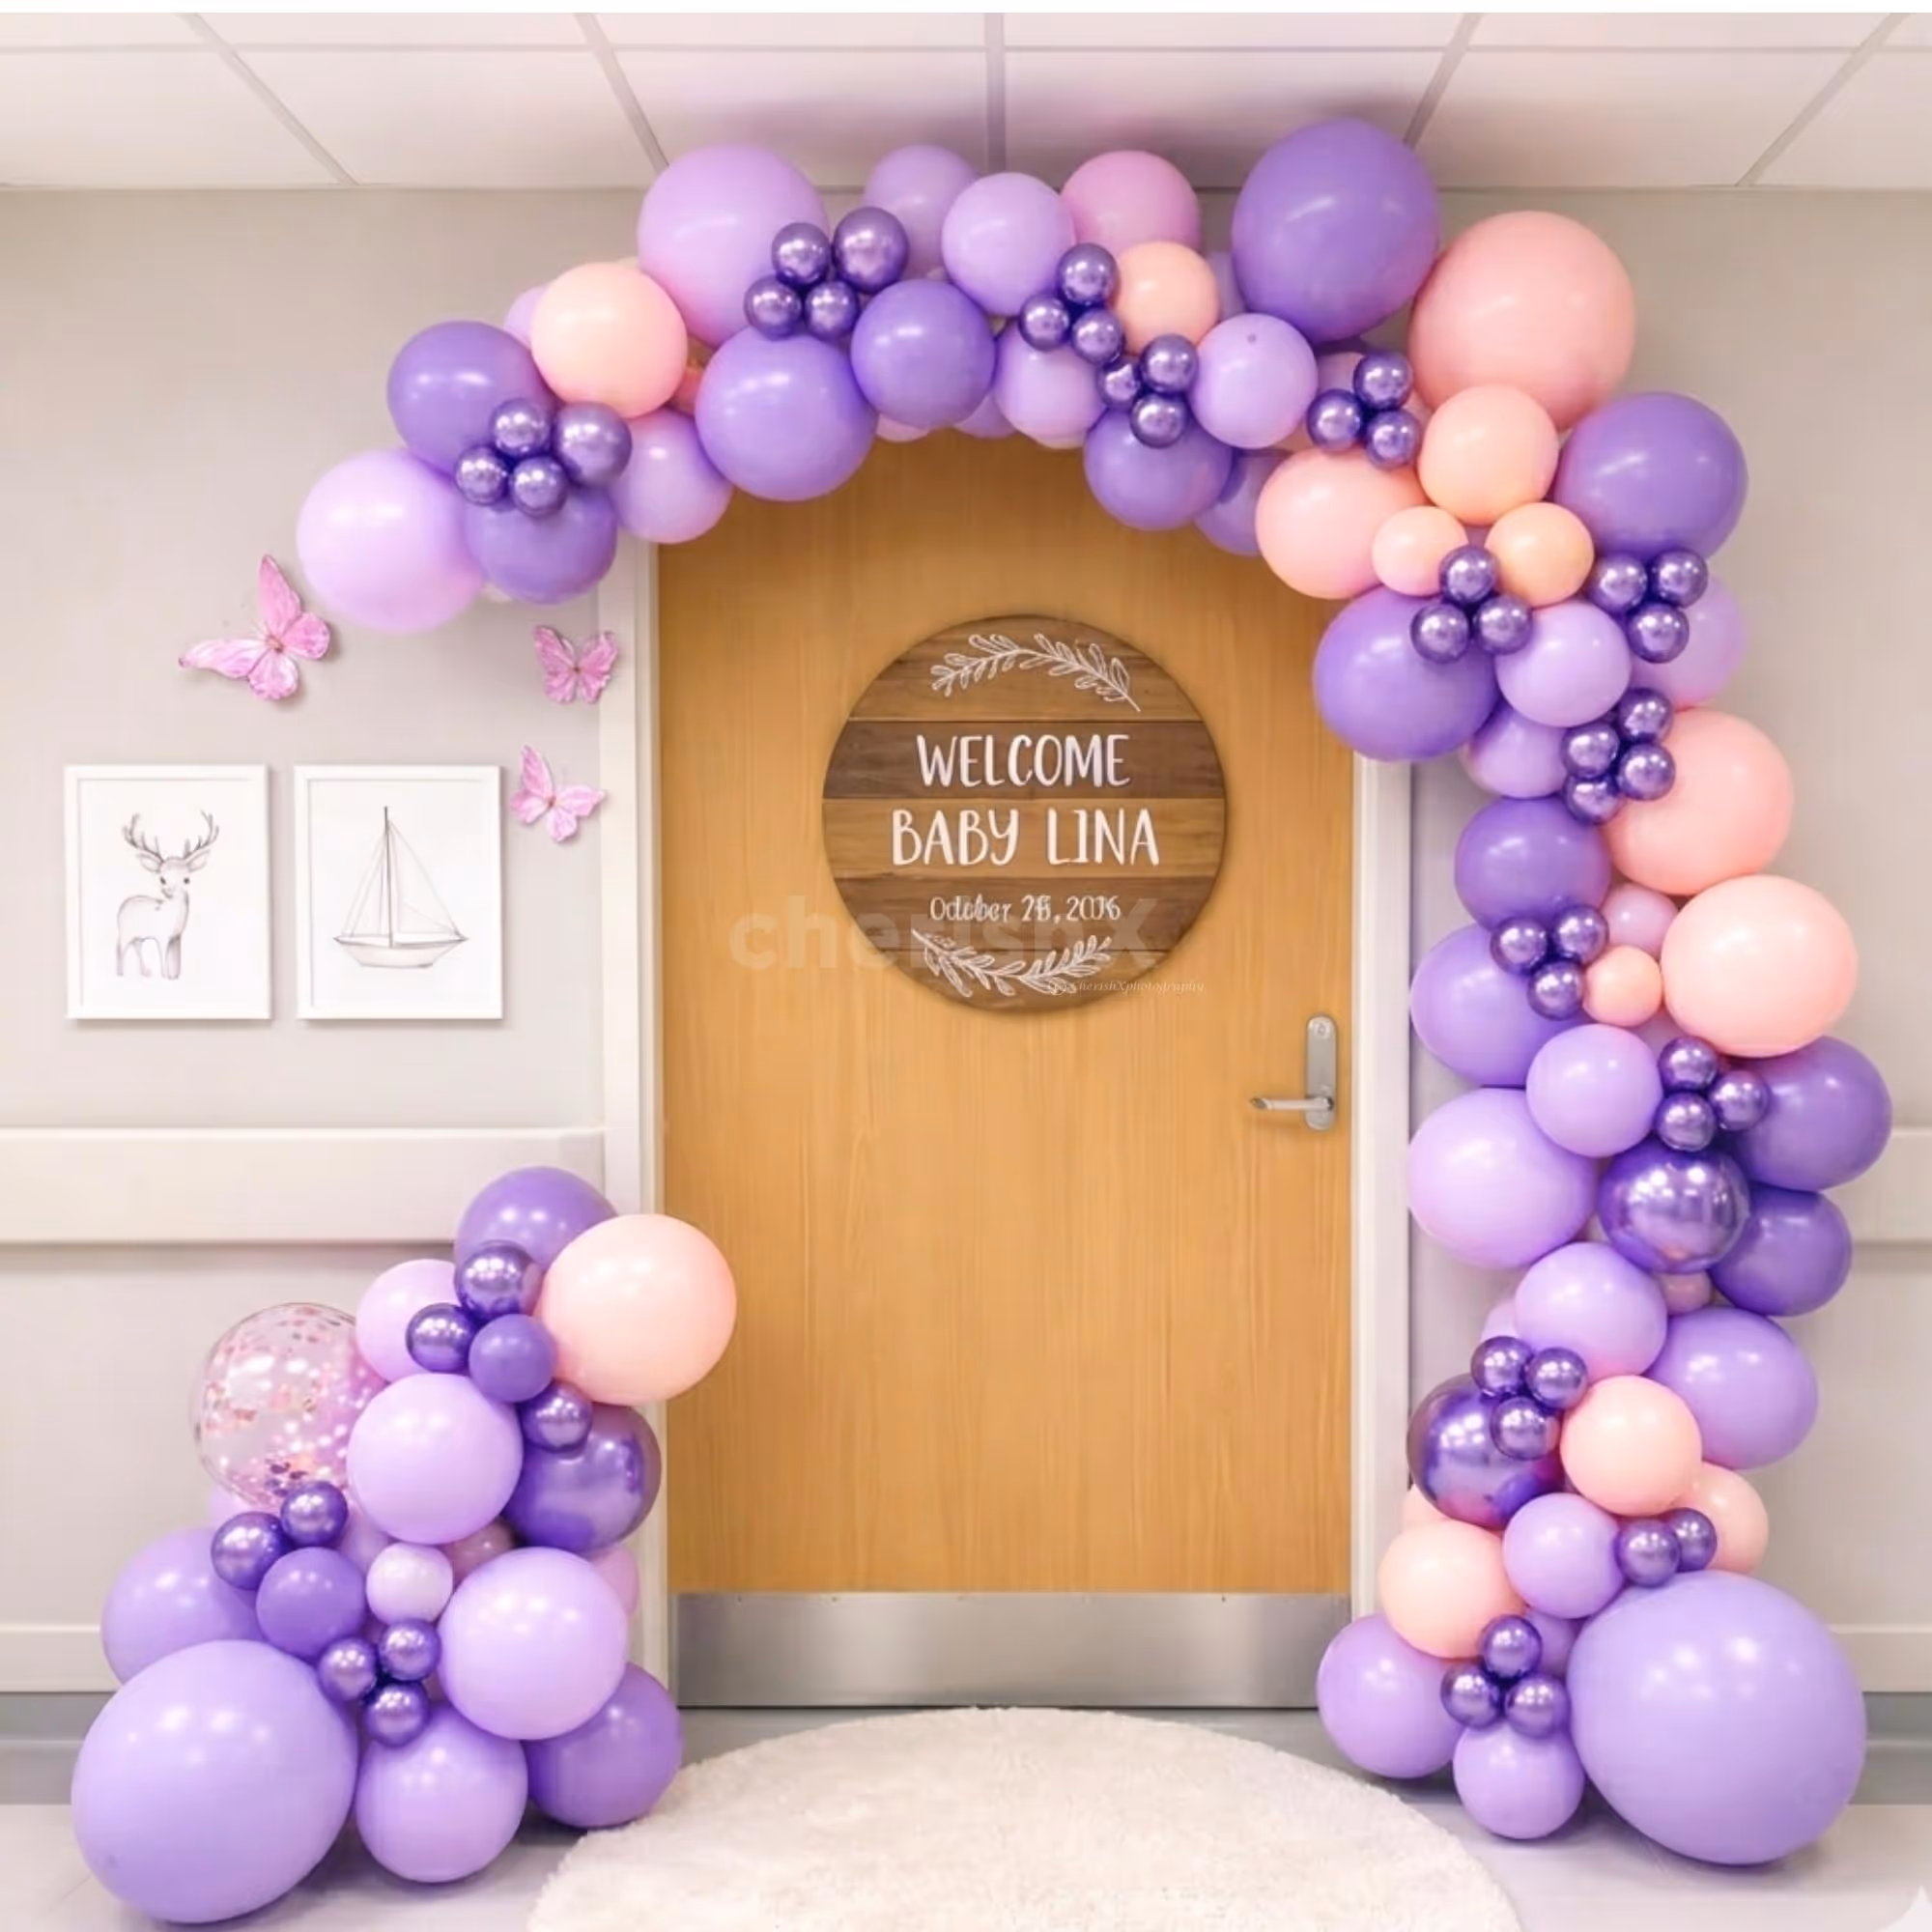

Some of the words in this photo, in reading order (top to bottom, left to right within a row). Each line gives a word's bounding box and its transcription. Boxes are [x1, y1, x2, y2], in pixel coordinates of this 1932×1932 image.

[917, 734, 1130, 787] WELCOME
[893, 808, 1019, 866] BABY
[1047, 808, 1159, 866] LINA
